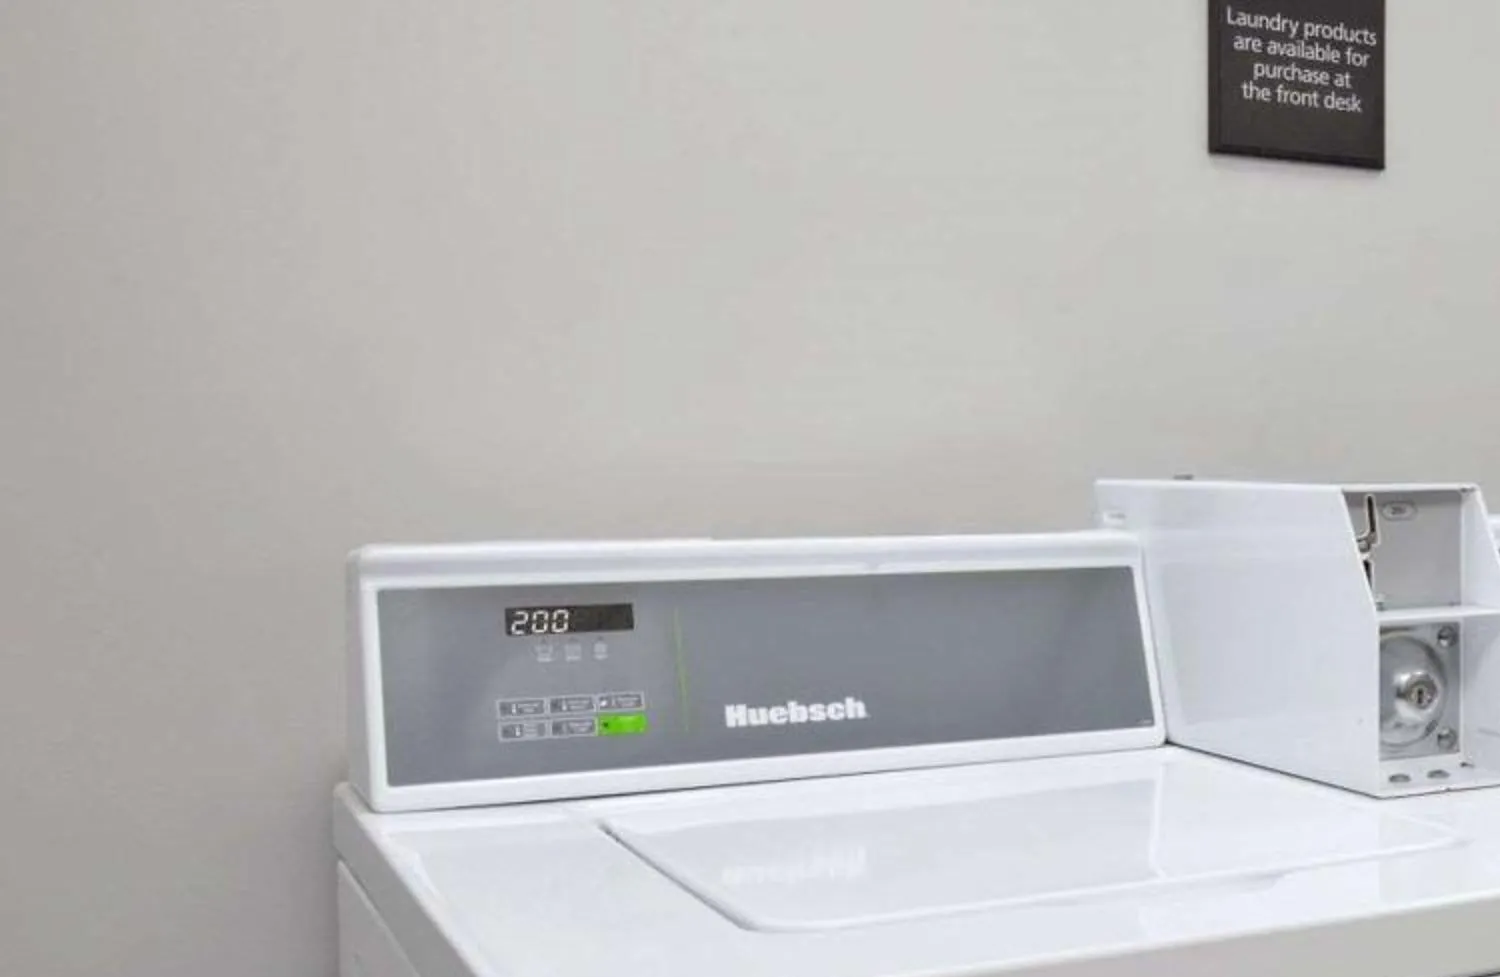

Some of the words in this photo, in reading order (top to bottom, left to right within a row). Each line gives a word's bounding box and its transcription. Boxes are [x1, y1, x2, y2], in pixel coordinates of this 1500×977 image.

[1227, 5, 1299, 38] Laundry
[1303, 22, 1377, 46] products
[1233, 35, 1262, 53] are
[1267, 40, 1341, 64] available
[1346, 47, 1370, 68] for
[1253, 62, 1330, 86] purchase
[1334, 71, 1352, 89] at
[1241, 80, 1272, 102] the
[1276, 84, 1319, 108] front
[1324, 91, 1363, 113] desk
[510, 608, 570, 636] 200
[725, 697, 868, 728] Huebsch
